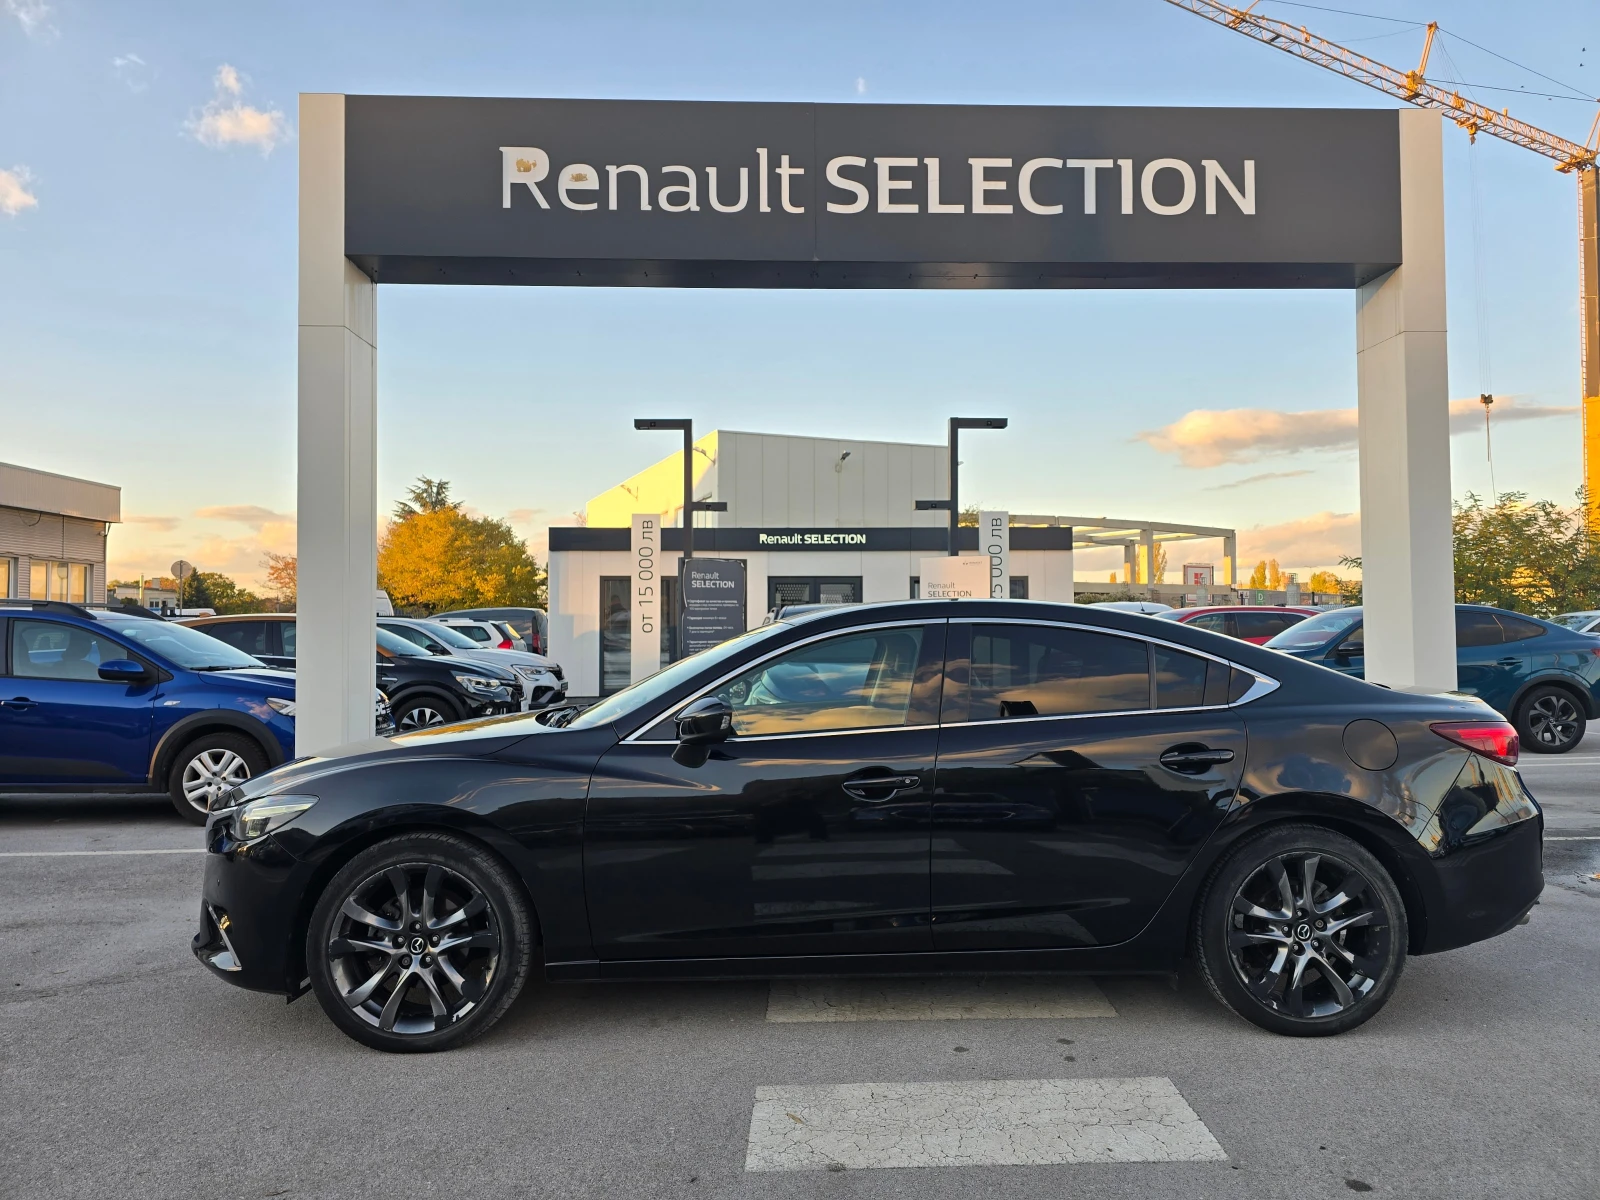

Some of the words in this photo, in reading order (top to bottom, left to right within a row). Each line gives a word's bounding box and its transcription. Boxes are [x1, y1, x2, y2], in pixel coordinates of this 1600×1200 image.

[499, 146, 804, 213] Renault
[825, 156, 1256, 216] SELECTION
[759, 533, 803, 544] Renault
[804, 533, 866, 544] SELECTION
[638, 546, 654, 581] 000
[691, 571, 719, 580] Renault
[638, 586, 654, 607] 15
